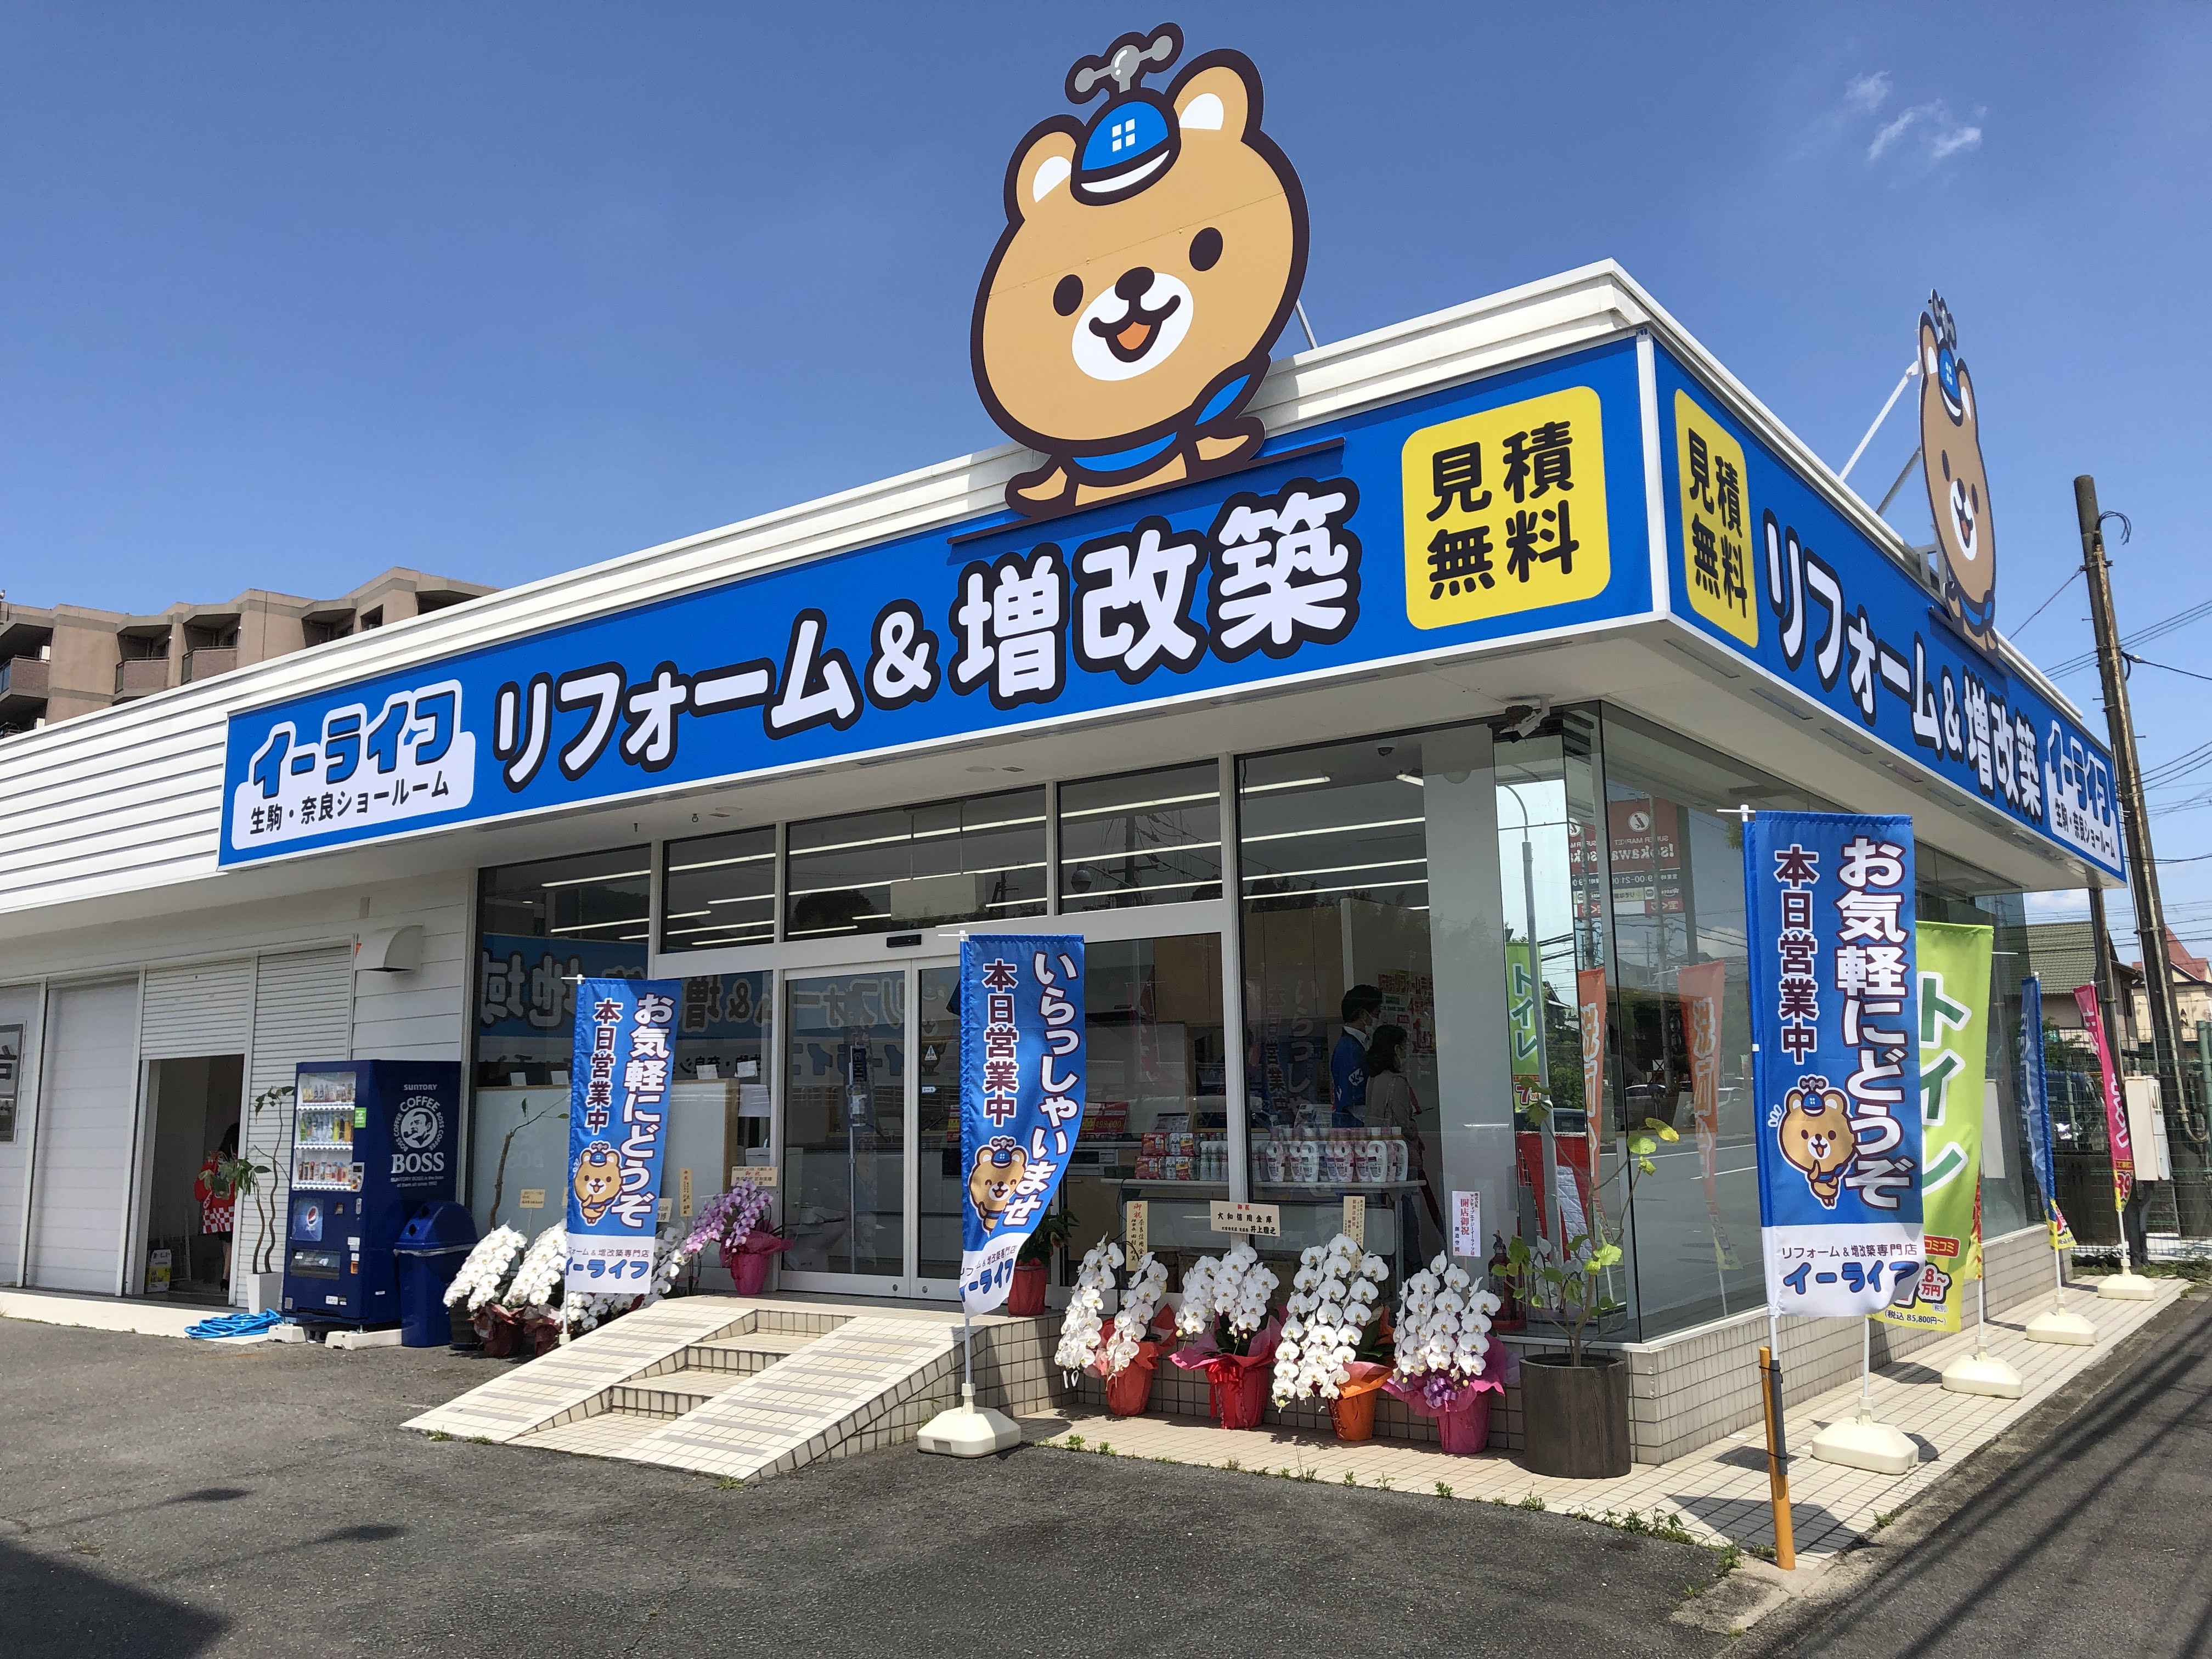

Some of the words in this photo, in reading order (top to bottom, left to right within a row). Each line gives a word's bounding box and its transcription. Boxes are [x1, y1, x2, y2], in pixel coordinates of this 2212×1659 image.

[1427, 420, 1574, 523] 見積
[1689, 427, 1742, 538] 見積
[1427, 500, 1580, 600] 無料
[1691, 513, 1747, 618] 無料
[495, 476, 1361, 792] リフォーム&増改築
[1764, 507, 2044, 824] リフォーム&増改築
[252, 687, 456, 800] イーライフ
[2049, 727, 2112, 828] イーライフ
[250, 770, 449, 835] 生駒・奈良ショールーム
[2055, 798, 2116, 860] 生駒・奈良ショールーム
[1774, 843, 1820, 1065] 本日営業中
[585, 997, 624, 1135] 本日営業中
[981, 957, 1020, 1127] 本日営業中
[1833, 834, 1913, 1211] お気軽にどうぞ
[399, 1096, 440, 1112] COFFEE
[611, 992, 675, 1228] お気軽にどうぞ
[1003, 950, 1079, 1226] いらっしゃいませ
[391, 1152, 444, 1173] BOSS
[1217, 1211, 1272, 1224] 大和信用金庫
[1460, 1198, 1470, 1235] 開店御祝
[1782, 1243, 1917, 1259] リフォーム&増改築専門店
[1925, 1239, 1955, 1254] コミコミ
[1782, 1260, 1920, 1295] イーライフ
[1921, 1283, 1942, 1297] 万円
